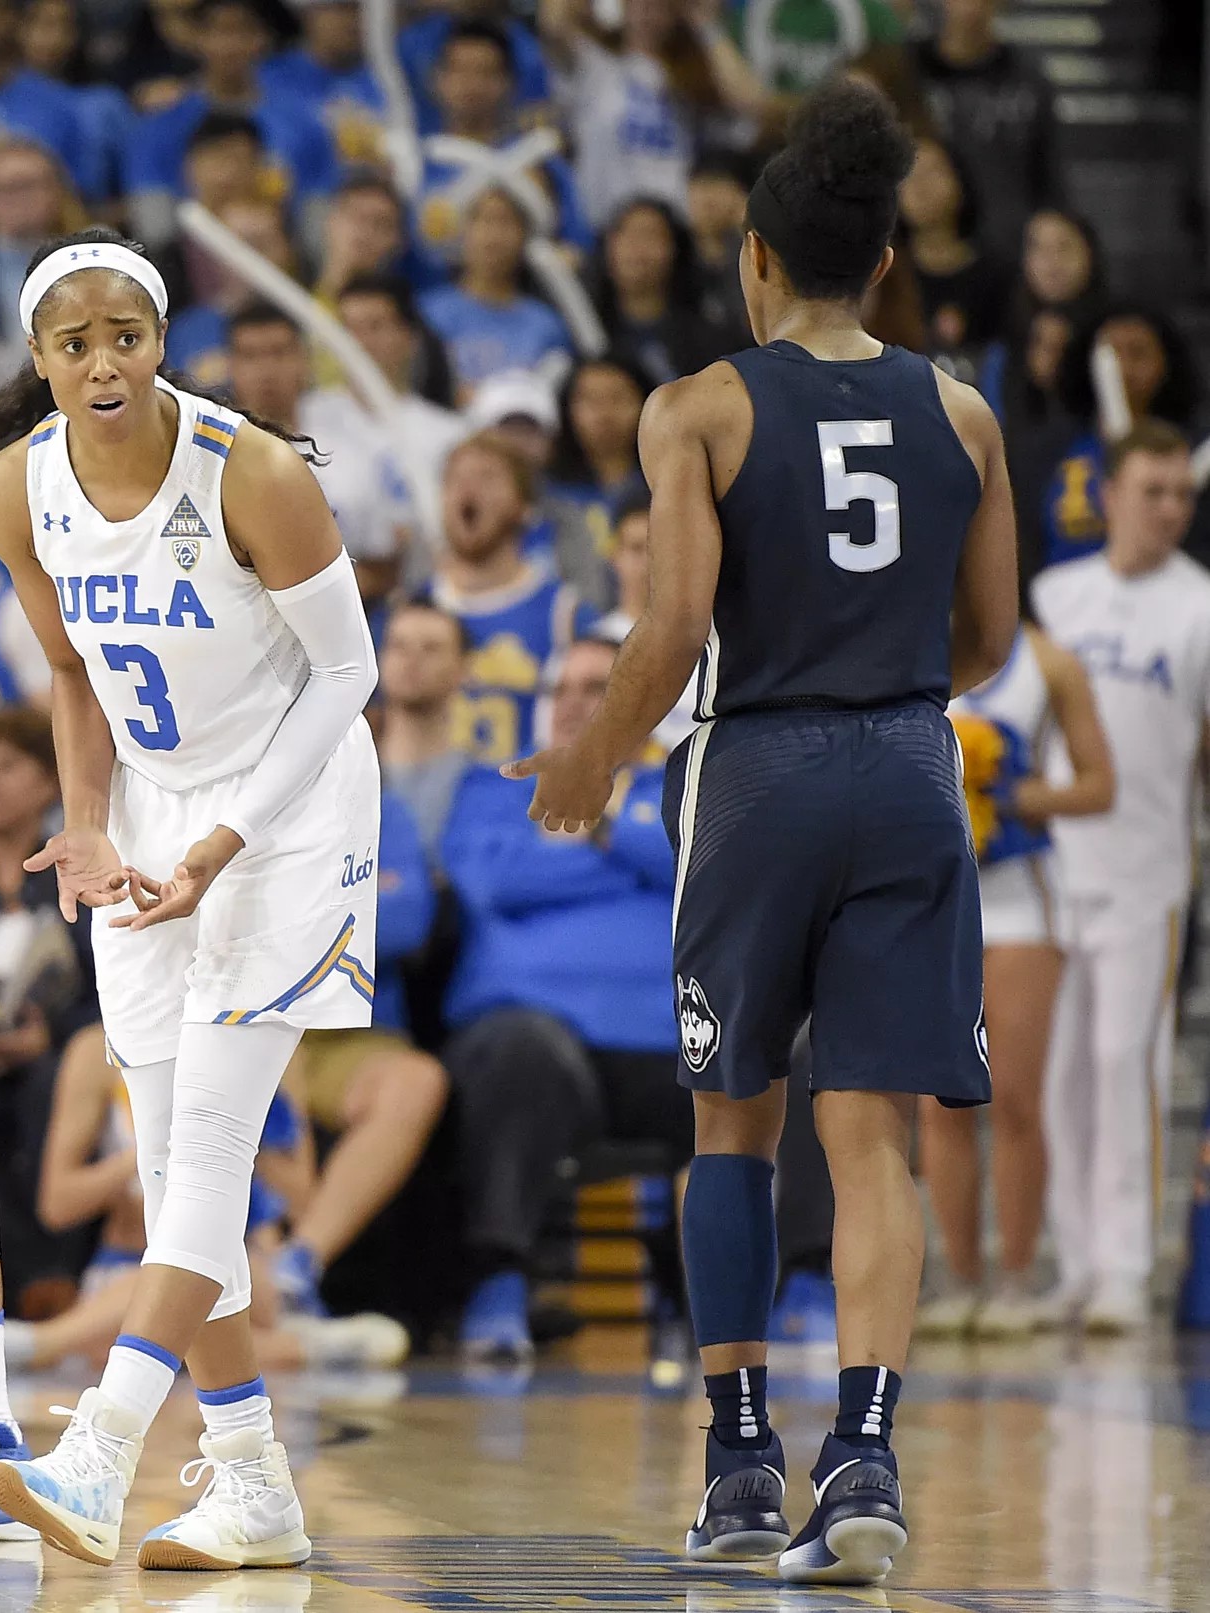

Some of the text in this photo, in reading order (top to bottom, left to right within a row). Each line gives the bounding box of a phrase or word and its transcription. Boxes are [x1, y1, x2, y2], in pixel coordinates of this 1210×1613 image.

[816, 419, 902, 573] 5
[168, 520, 201, 534] JRW
[173, 541, 199, 559] PAC
[179, 553, 194, 566] 12
[56, 575, 215, 630] UCLA
[100, 643, 182, 752] 3
[733, 1475, 774, 1501] NIKE
[848, 1467, 895, 1492] NIKE
